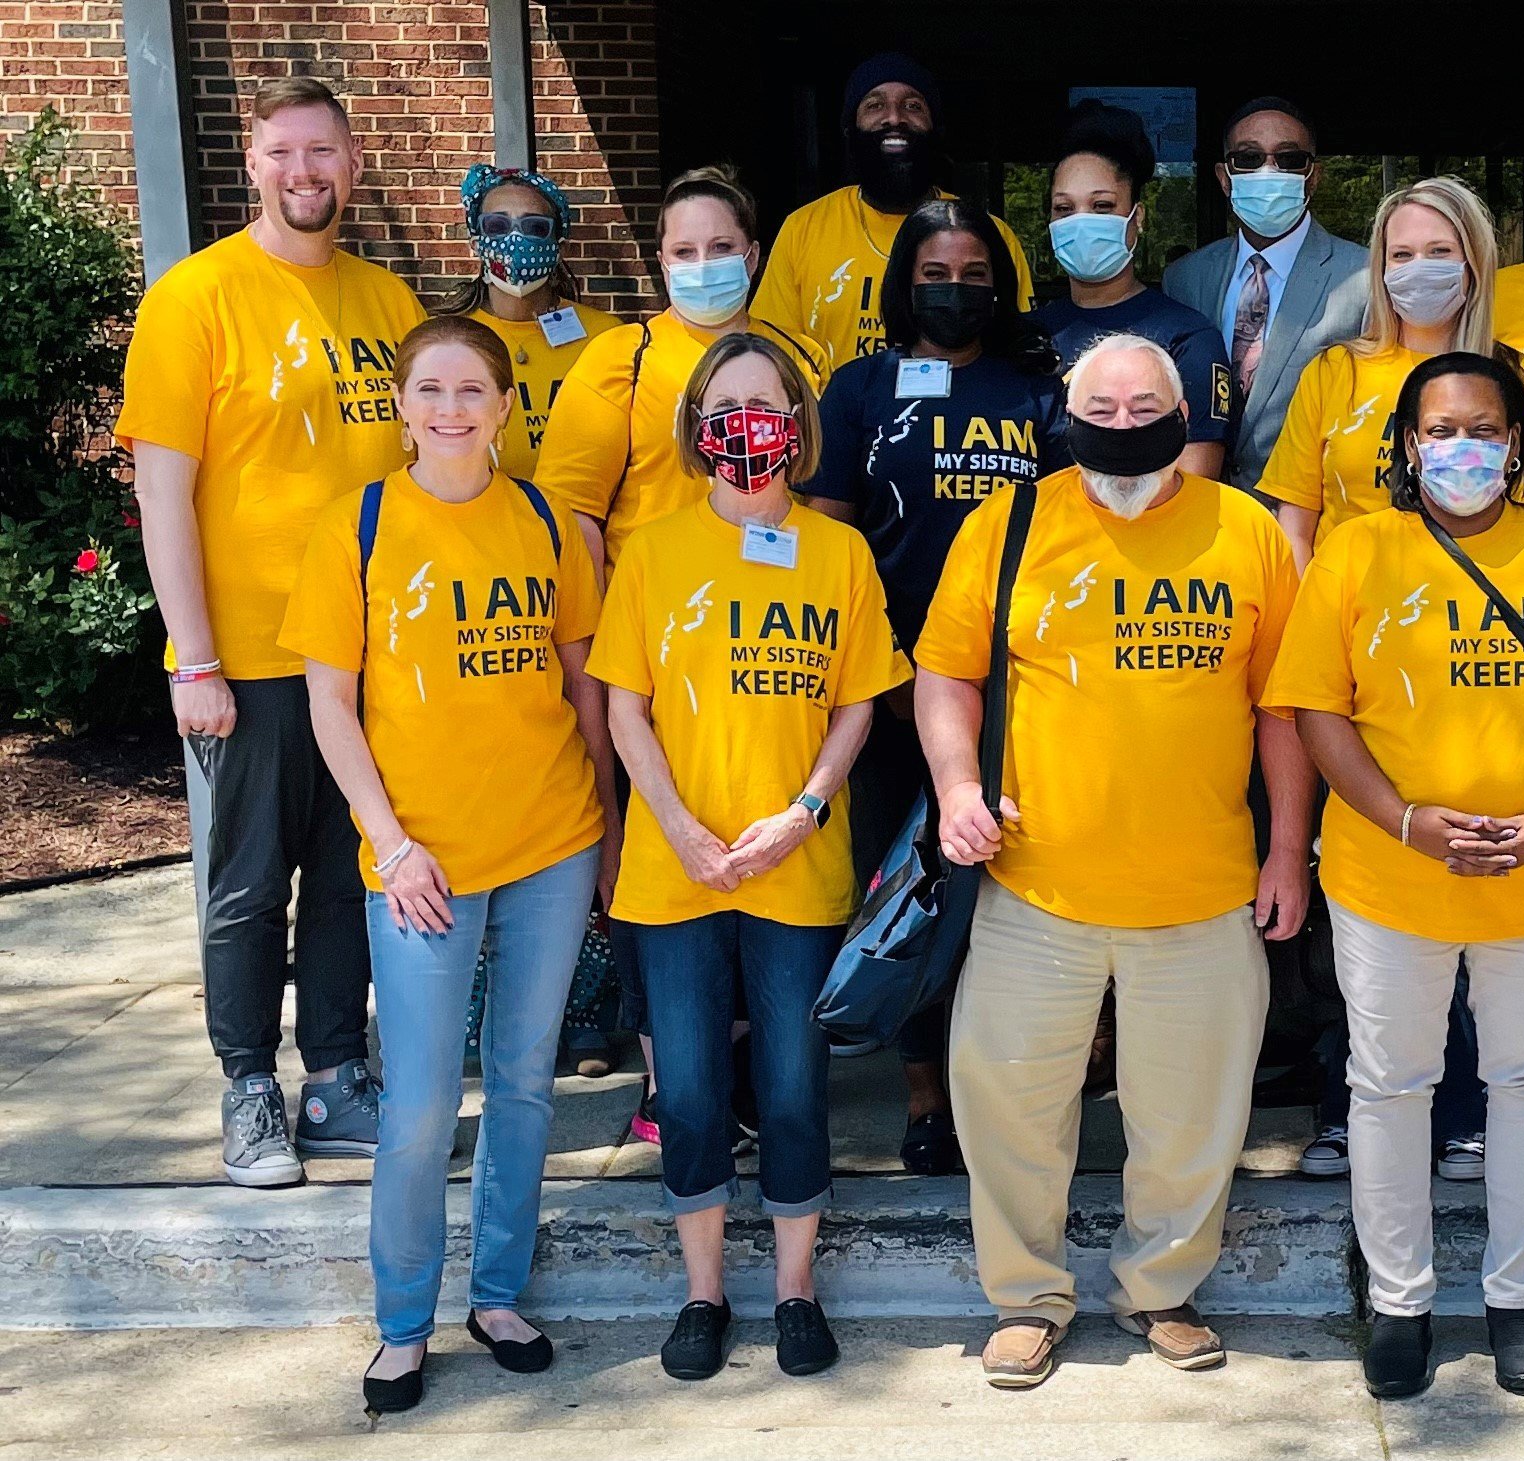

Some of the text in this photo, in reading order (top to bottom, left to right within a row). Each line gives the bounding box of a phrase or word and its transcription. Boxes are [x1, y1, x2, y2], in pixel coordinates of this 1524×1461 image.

[861, 276, 873, 310] I
[859, 316, 885, 331] MY
[321, 338, 340, 374] I
[335, 377, 395, 395] MY SIS
[518, 381, 532, 411] I
[933, 415, 1038, 459] I AM
[934, 453, 1038, 478] MY SISTER'S
[934, 473, 1032, 500] KEEP
[452, 576, 556, 621] I AM
[1114, 578, 1233, 619] I AM
[730, 600, 838, 650] I AM
[1447, 600, 1460, 631] I
[457, 627, 488, 645] MY
[1115, 621, 1232, 641] MY SISTER'S
[731, 646, 761, 662] MY
[1115, 644, 1224, 670] KEEPER
[1450, 639, 1482, 653] MY
[458, 646, 547, 678] KEEPE
